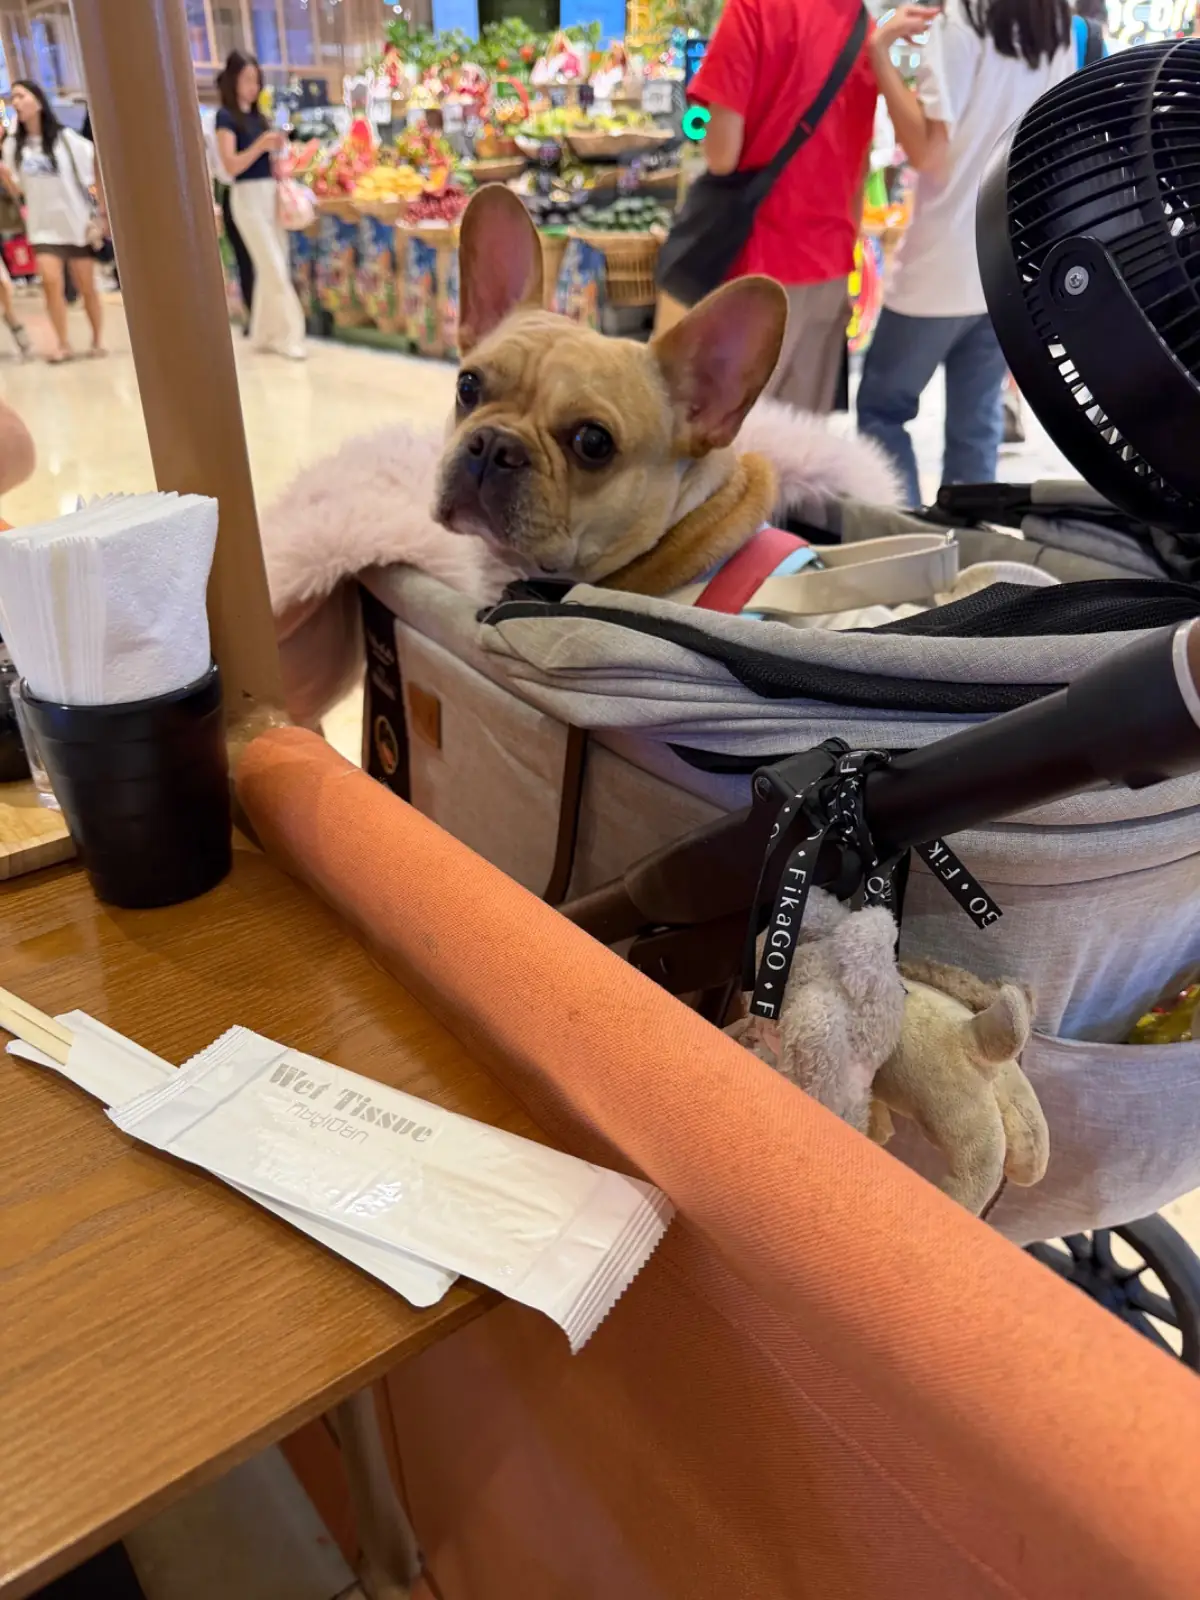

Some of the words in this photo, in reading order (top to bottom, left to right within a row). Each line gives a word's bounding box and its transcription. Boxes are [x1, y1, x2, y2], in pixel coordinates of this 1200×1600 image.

[765, 867, 807, 971] FikaGO
[268, 1063, 333, 1101] Wet
[333, 1088, 433, 1143] Tissue
